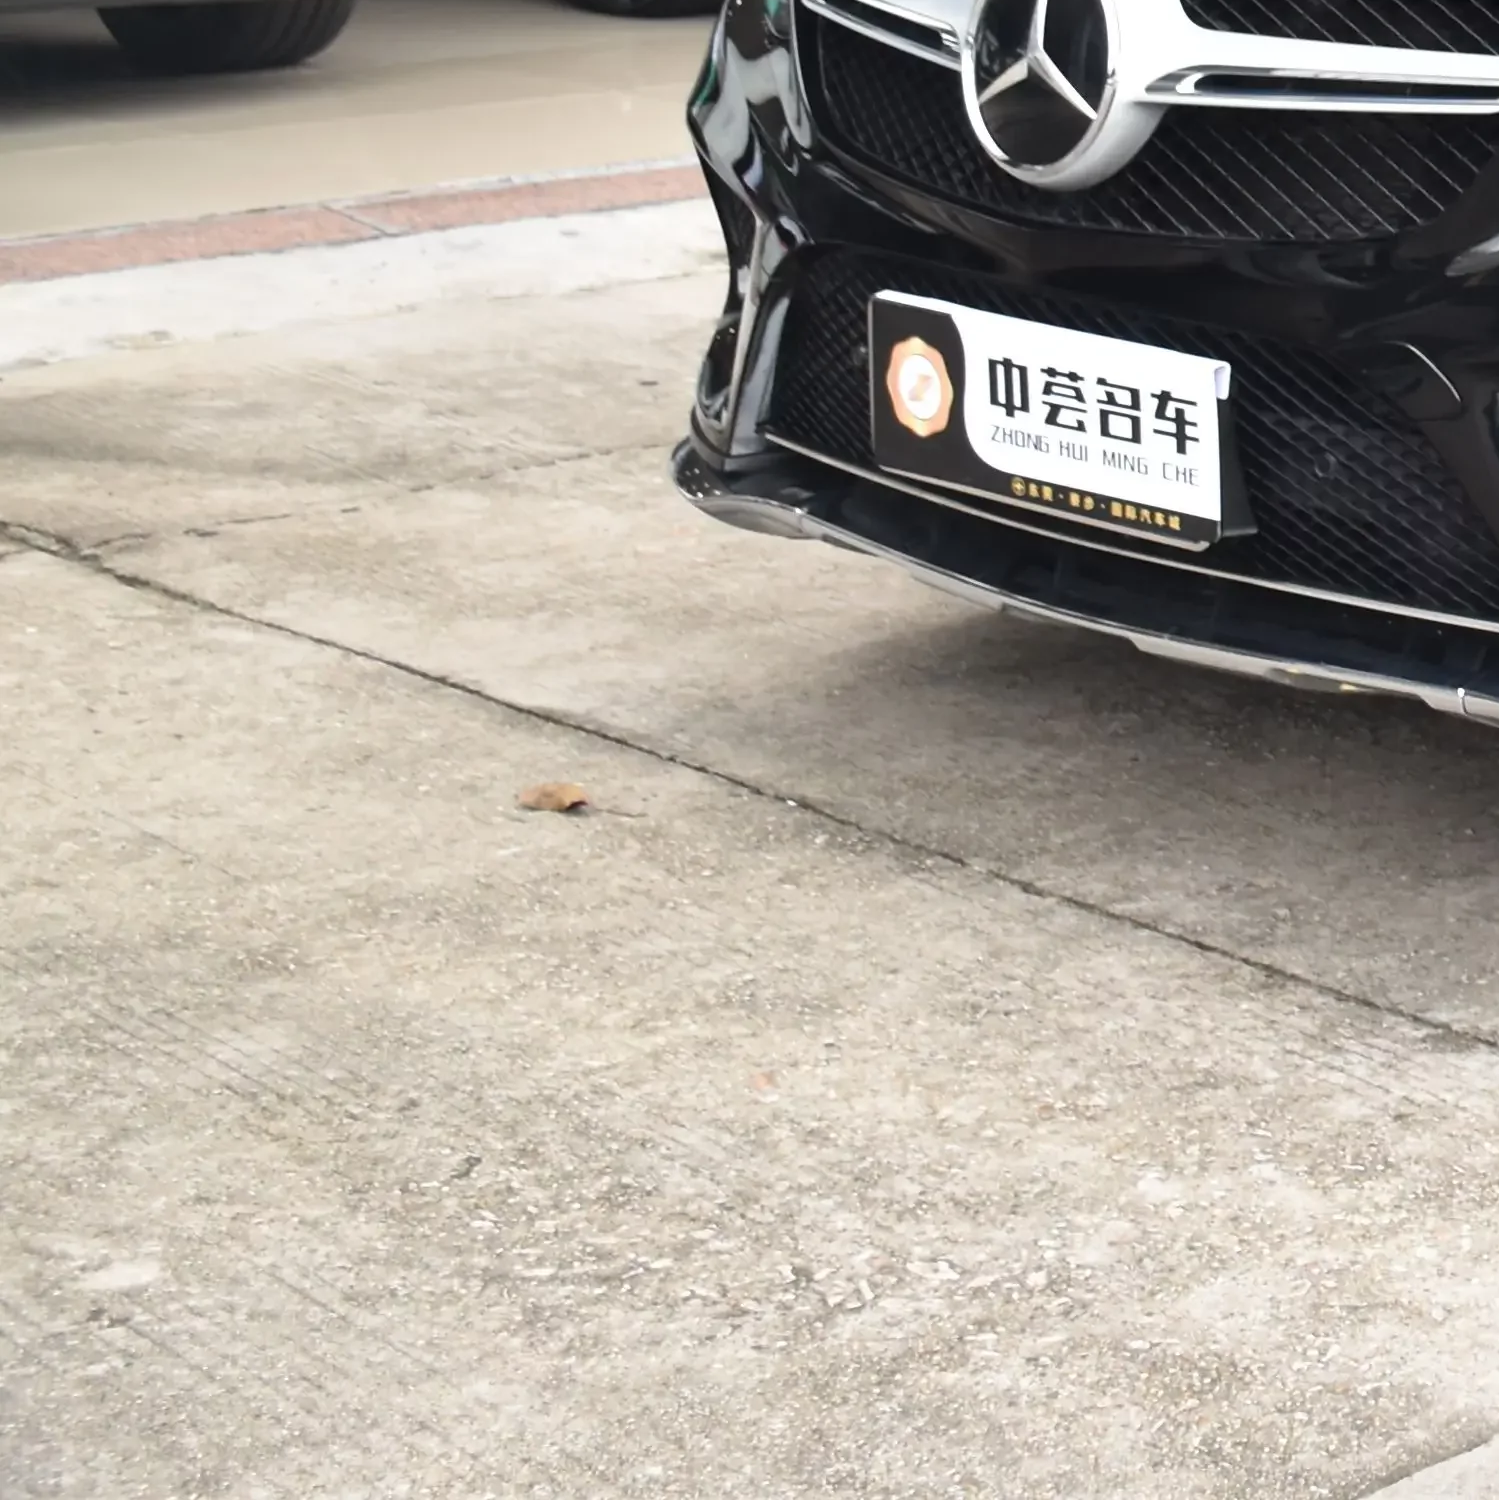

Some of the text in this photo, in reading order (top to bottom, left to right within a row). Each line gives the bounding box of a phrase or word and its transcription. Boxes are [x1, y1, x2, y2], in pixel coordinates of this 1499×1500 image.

[987, 356, 1201, 456] 中荟名车
[990, 424, 1200, 487] ZHONG HUI MING CHE
